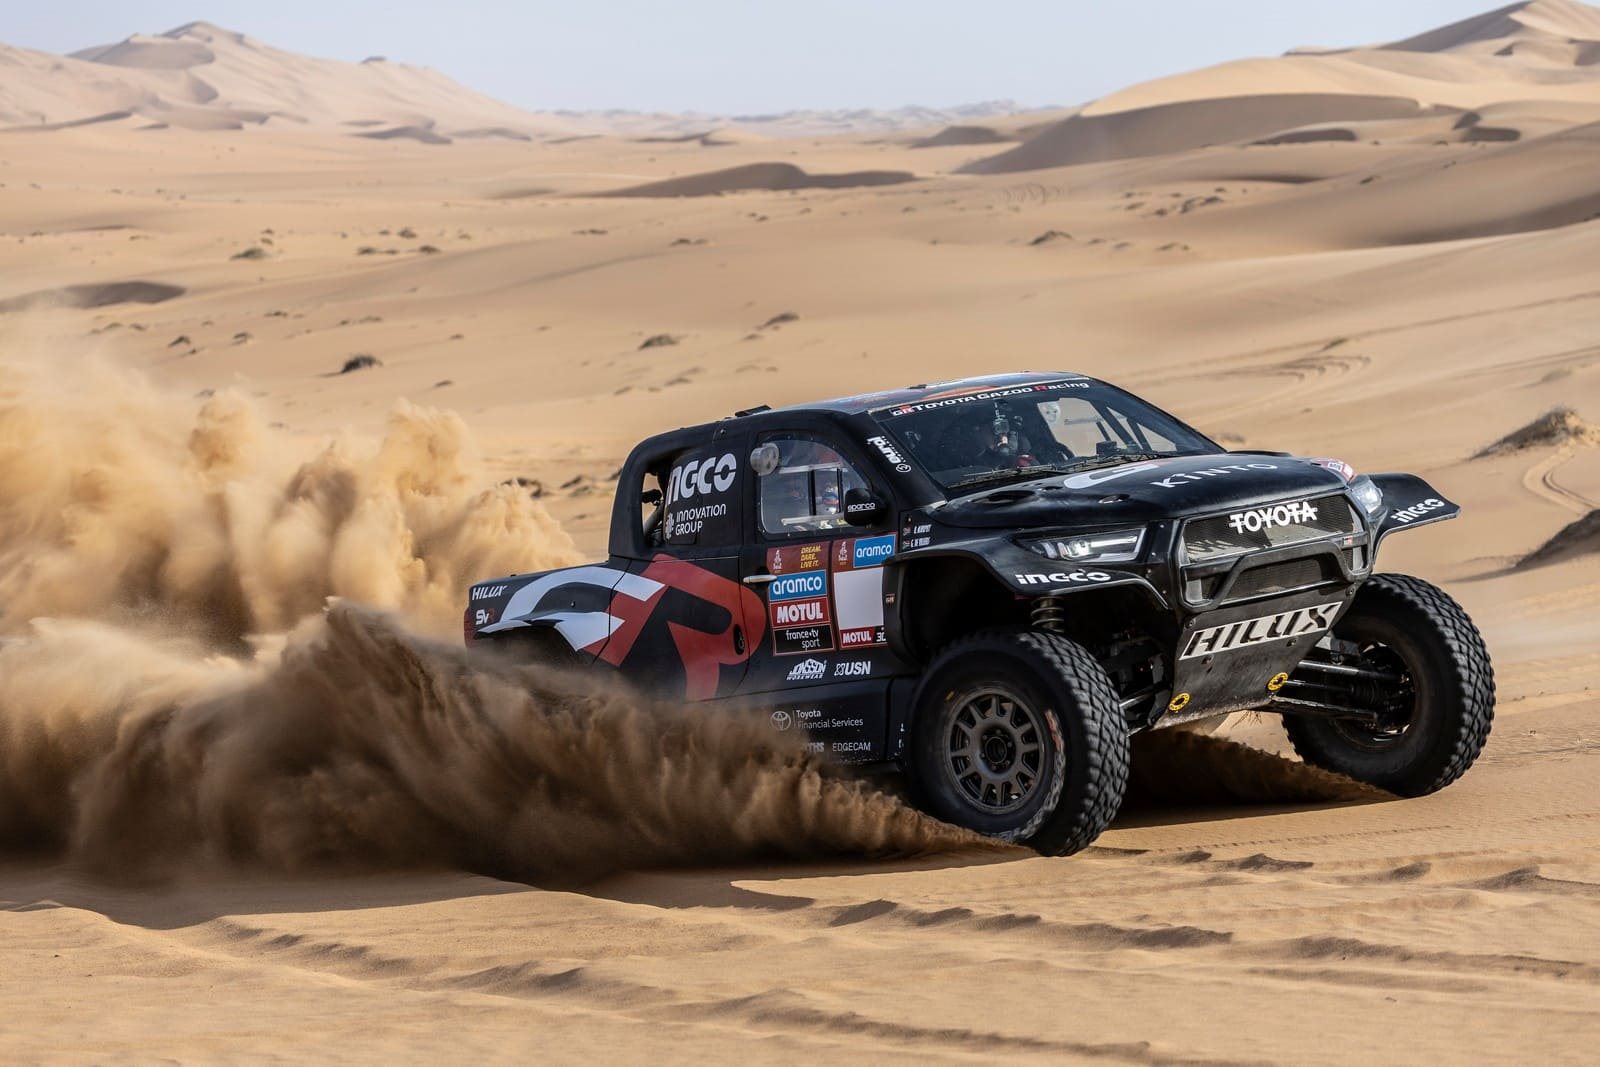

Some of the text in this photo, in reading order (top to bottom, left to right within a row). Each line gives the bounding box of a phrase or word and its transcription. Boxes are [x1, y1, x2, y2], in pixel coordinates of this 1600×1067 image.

[915, 396, 977, 411] TOYOTA
[977, 387, 1033, 401] GAZOO
[1033, 381, 1090, 394] Racing
[1149, 463, 1279, 488] KINTO
[676, 503, 727, 523] INNOVATION
[847, 502, 876, 513] sparco
[1229, 501, 1318, 534] TOYOTA
[675, 521, 703, 536] GROUP
[856, 544, 892, 558] aramco
[472, 585, 508, 601] HILUX
[772, 576, 822, 595] aramco
[777, 602, 823, 623] MOTUL
[1184, 602, 1338, 656] HILUX
[802, 638, 821, 651] sport
[843, 631, 872, 644] MOTUL
[844, 661, 871, 675] USN
[796, 710, 822, 719] Toyota
[797, 717, 864, 729] Financial Services
[832, 742, 871, 752] EDGECAM
